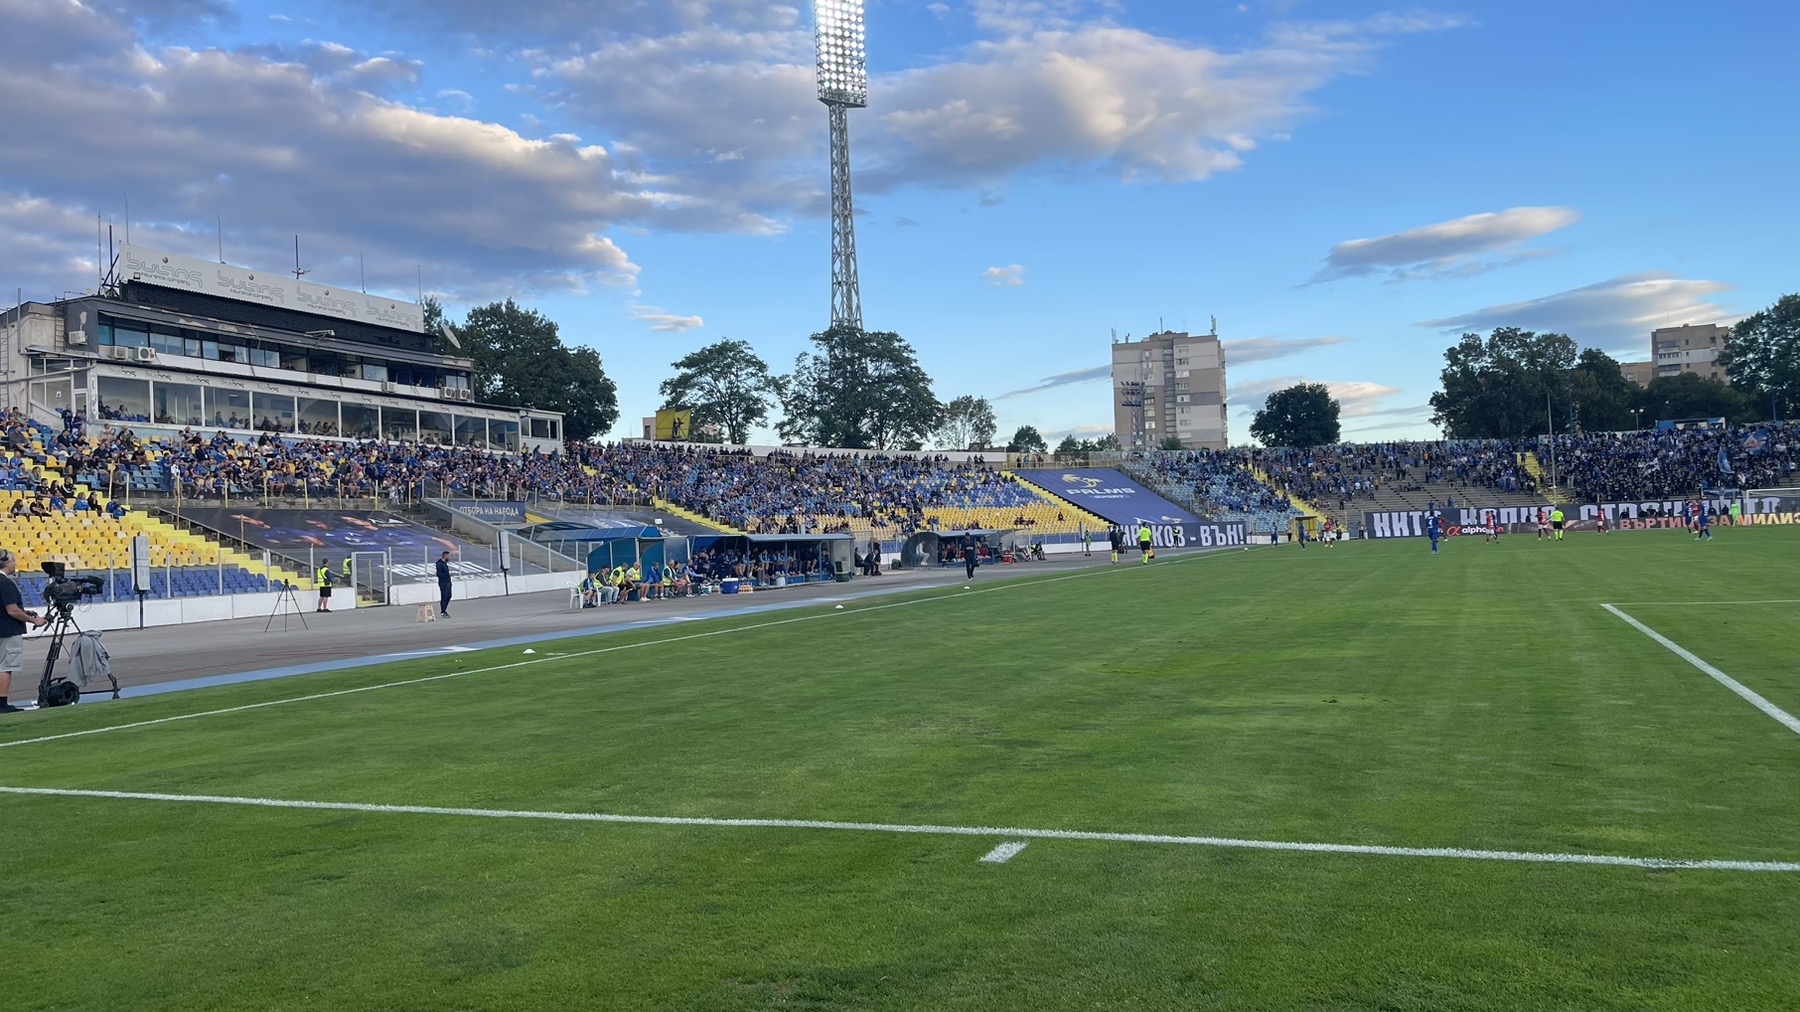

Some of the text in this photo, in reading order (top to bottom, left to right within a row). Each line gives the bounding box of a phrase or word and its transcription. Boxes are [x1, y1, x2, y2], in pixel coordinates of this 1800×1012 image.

[140, 272, 190, 286] insurance company
[230, 288, 273, 301] insurance company
[1066, 487, 1135, 495] PALMS
[460, 506, 519, 516] ОТБОРА НА НАРОДА
[1706, 514, 1731, 527] ЗА
[1111, 524, 1186, 547] ИРКОВ
[1200, 523, 1245, 546] ВЪН!
